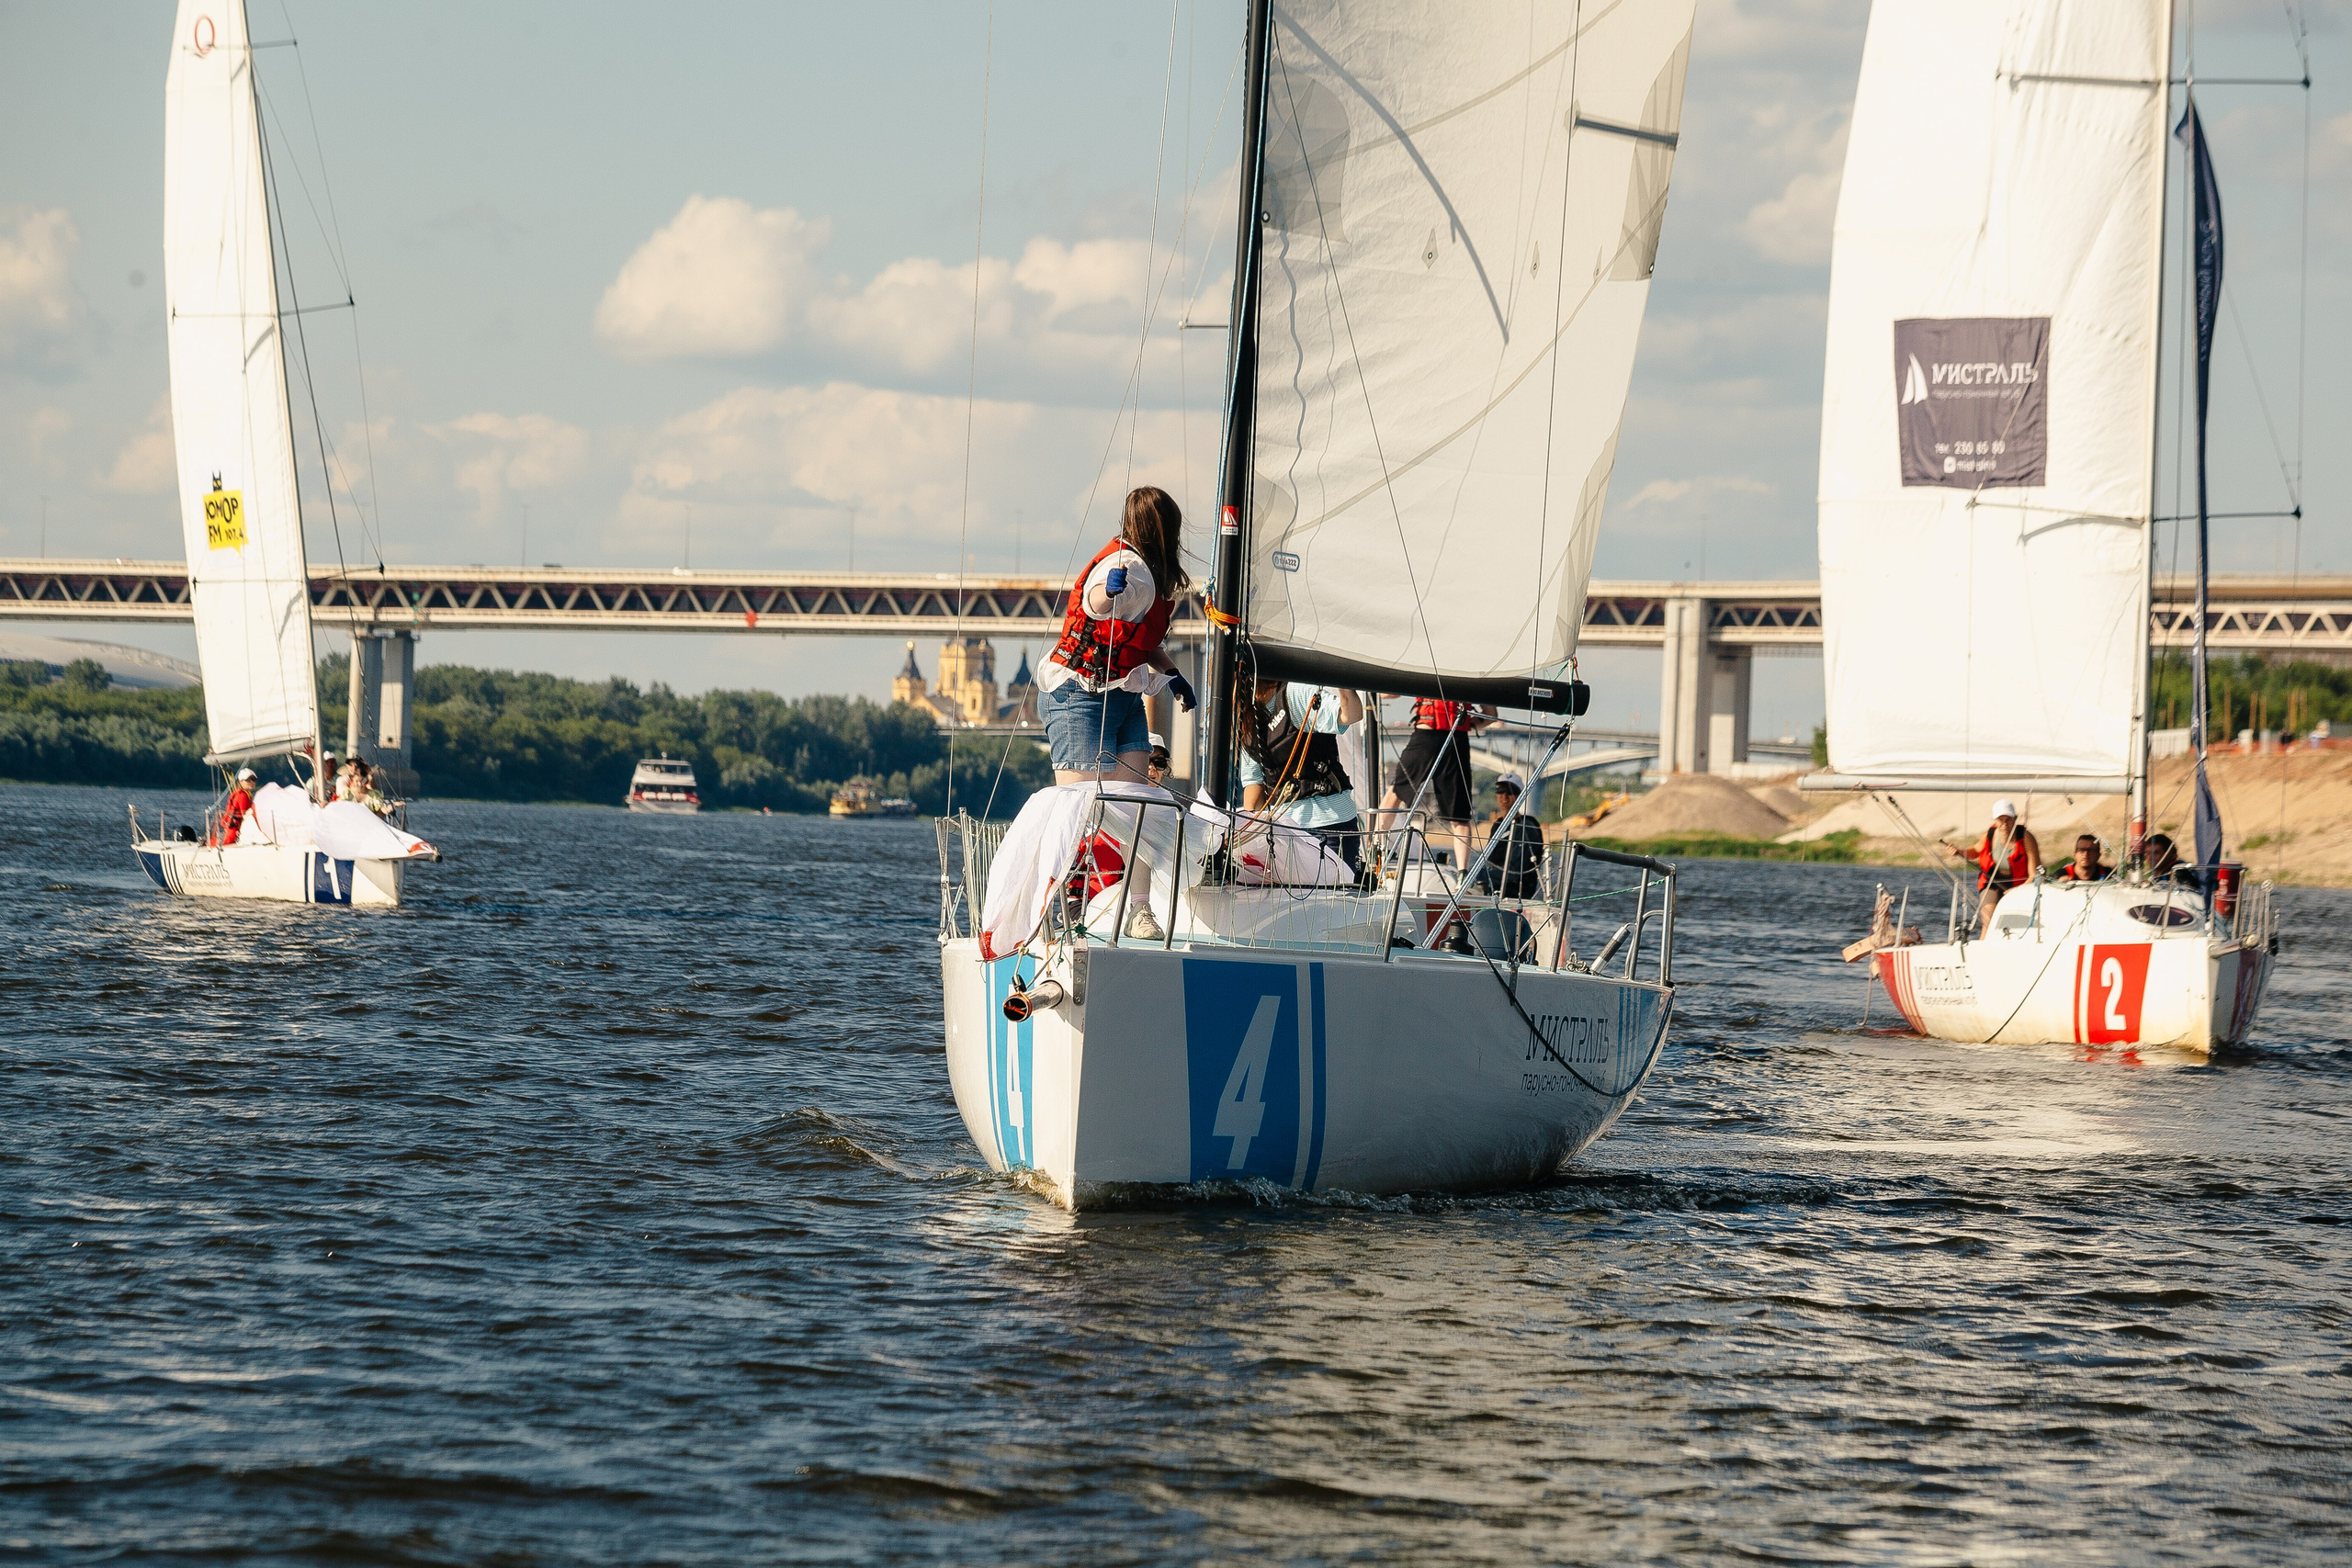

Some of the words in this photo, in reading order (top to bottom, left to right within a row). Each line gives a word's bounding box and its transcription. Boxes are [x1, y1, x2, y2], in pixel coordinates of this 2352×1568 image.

[1931, 363, 2039, 385] МИСТРАЛЬ
[205, 497, 238, 523] ЮМОР
[209, 524, 222, 544] FM
[1268, 709, 1286, 732] hiko
[323, 856, 342, 899] 1
[2100, 956, 2127, 1031] 2
[1526, 1014, 1610, 1064] МИСТРАЛЬ
[1213, 995, 1282, 1170] 4
